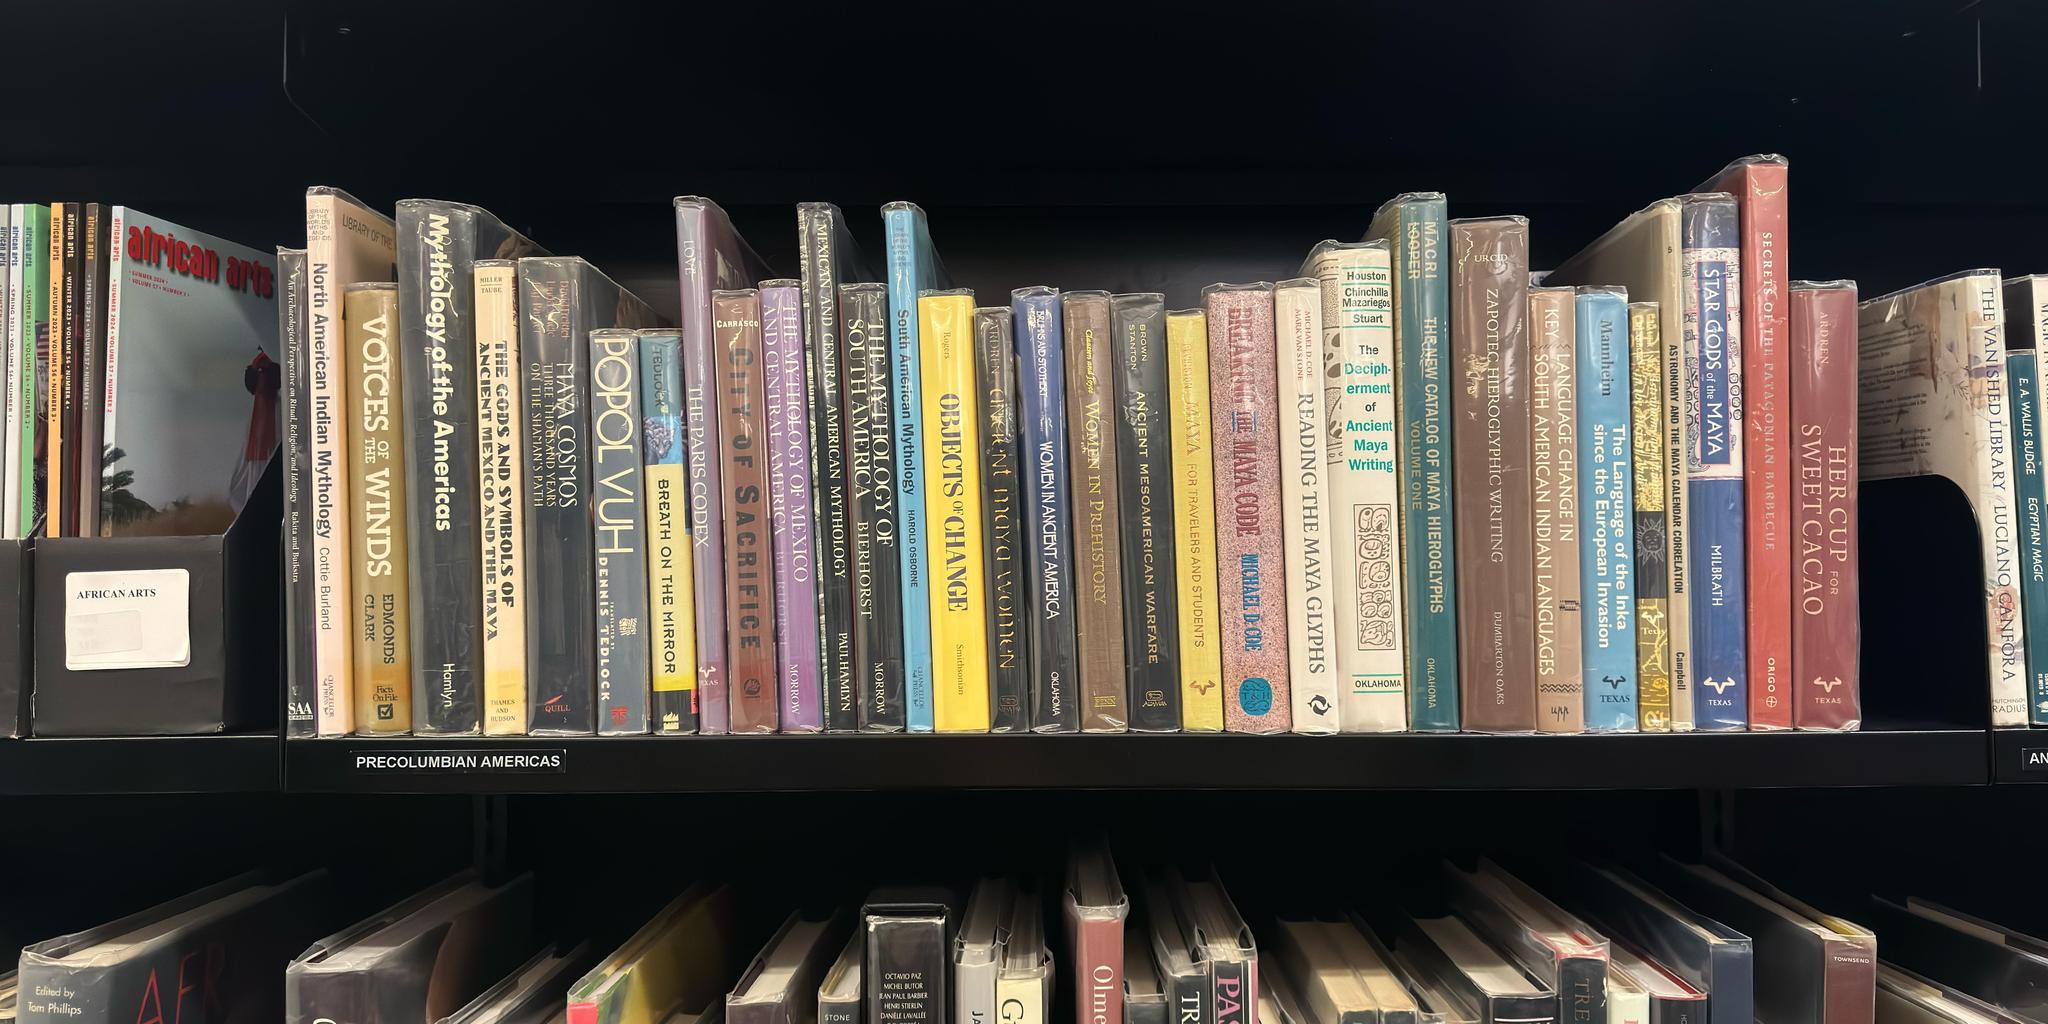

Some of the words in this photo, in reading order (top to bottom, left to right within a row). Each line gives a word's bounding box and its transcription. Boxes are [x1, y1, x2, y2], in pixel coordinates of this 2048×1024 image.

[342, 213, 370, 239] LIBRARY
[371, 229, 380, 241] OF
[127, 225, 218, 283] african
[226, 255, 272, 298] arts
[1424, 221, 1437, 279] MACRI
[1474, 254, 1508, 262] URCID
[313, 263, 328, 308] North
[424, 213, 454, 344] Mythology
[1345, 287, 1389, 297] Chinchilla
[1346, 271, 1387, 281] Houston
[1704, 268, 1719, 313] STAR
[287, 293, 296, 346] Archaeological
[716, 320, 759, 328] CARRASCO
[1342, 298, 1391, 309] Mazariegos
[1353, 314, 1383, 324] Stuart
[1544, 309, 1559, 339] KEY
[867, 319, 885, 366] THE
[897, 309, 909, 350] South
[944, 331, 952, 360] Rogers
[1128, 324, 1137, 371] STANTON
[1139, 324, 1148, 362] BROWN
[1359, 345, 1379, 355] The
[1705, 319, 1721, 370] GODS
[1820, 311, 1829, 364] ARDREN
[288, 346, 297, 385] Perspective
[314, 313, 329, 390] American
[432, 347, 453, 372] of
[494, 340, 508, 378] THE
[848, 319, 867, 395] SOUTH
[1345, 363, 1392, 377] Deciph-
[1600, 320, 1615, 397] Mannheim
[362, 316, 390, 432] VOICES
[433, 374, 454, 416] the
[556, 363, 576, 419] MAYA
[728, 348, 754, 418] CITY
[900, 354, 912, 419] American
[1346, 383, 1391, 394] erment
[1706, 372, 1714, 382] of
[1706, 385, 1714, 399] the
[2019, 378, 2029, 387] E.
[2020, 389, 2030, 399] A.
[290, 399, 298, 422] Ritual,
[316, 395, 331, 445] Indian
[496, 383, 510, 438] GODS
[594, 338, 634, 464] POPOL
[688, 387, 704, 422] THE
[1365, 402, 1377, 412] of
[2021, 402, 2033, 437] WALLIS
[290, 424, 299, 456] Religion,
[869, 372, 892, 514] MYTHOLOGY
[939, 393, 964, 498] OBJECTS
[1298, 393, 1318, 486] READING
[1346, 420, 1393, 432] Ancient
[1354, 438, 1388, 453] Maya
[1706, 402, 1723, 455] MAYA
[291, 459, 299, 473] and
[365, 437, 375, 464] THE
[378, 440, 388, 458] OF
[496, 442, 511, 482] AND
[557, 425, 578, 509] COSMOS
[690, 426, 706, 479] PARIS
[733, 435, 753, 468] OF
[851, 400, 873, 500] AMERICA
[901, 423, 915, 496] Mythology
[1039, 441, 1054, 486] WOMEN
[1349, 458, 1393, 473] Writing
[2024, 439, 2036, 475] BUDGE
[290, 474, 300, 503] Ideology
[316, 450, 333, 539] Mythology
[433, 421, 455, 531] Americas
[1040, 488, 1055, 503] IN
[365, 467, 393, 577] WINDS
[598, 467, 634, 553] VUH
[658, 479, 671, 540] BREATH
[692, 482, 709, 548] CODEX
[908, 509, 917, 546] HAROLD
[953, 500, 964, 515] OF
[1302, 491, 1319, 533] THE
[2028, 497, 2041, 545] EGYPTIAN
[497, 485, 514, 576] SYMBOLS
[876, 523, 894, 547] OF
[1042, 506, 1057, 558] ANCIENT
[319, 547, 329, 583] Cottie
[660, 546, 672, 569] ON
[735, 485, 761, 649] SACRIFICE
[857, 521, 873, 619] BIERHORST
[910, 546, 919, 588] OSBORNE
[943, 516, 969, 613] CHANGE
[1303, 537, 1321, 593] MAYA
[1711, 545, 1723, 607] MILBRATH
[2032, 548, 2044, 582] MAGIC
[77, 590, 125, 599] AFRICAN
[128, 589, 157, 598] ARTS
[321, 586, 331, 630] Burland
[500, 580, 514, 608] OF
[598, 557, 610, 617] DENNIS
[661, 576, 673, 605] THE
[1044, 561, 1060, 620] AMERICA
[364, 594, 375, 642] CLARK
[382, 594, 395, 665] EDMONDS
[1306, 596, 1325, 674] GLYPHS
[663, 611, 676, 673] MIRROR
[1494, 611, 1503, 674] DUMBARTON
[601, 626, 611, 701] TEDLOCK
[956, 643, 964, 696] Smithsonian
[1355, 680, 1402, 688] OKLAHOMA
[1426, 658, 1437, 708] OKLAHOMA
[1676, 651, 1686, 690] Campbell
[1767, 657, 1776, 693] ORIGO
[440, 663, 456, 708] Hamlyn
[789, 664, 801, 715] MORROW
[874, 662, 887, 715] MORROW
[1050, 671, 1060, 716] OKLAHOMA
[1496, 680, 1505, 705] OAKS
[1600, 694, 1630, 703] TEXAS
[544, 704, 570, 713] QUILL
[1992, 704, 2026, 713] RADIUS
[357, 755, 478, 769] PRECOLUMBIAN
[480, 754, 560, 768] AMERICAS
[1833, 956, 1870, 964] TOWNSEND
[35, 986, 61, 997] Edited
[64, 987, 75, 999] by
[884, 982, 903, 990] MICHEL
[904, 982, 923, 990] BUTOR
[884, 1002, 899, 1010] HENRI
[901, 1002, 923, 1010] STIERLIN
[27, 1002, 45, 1013] Tom
[48, 1001, 82, 1016] Phillips
[824, 1013, 850, 1021] STONE
